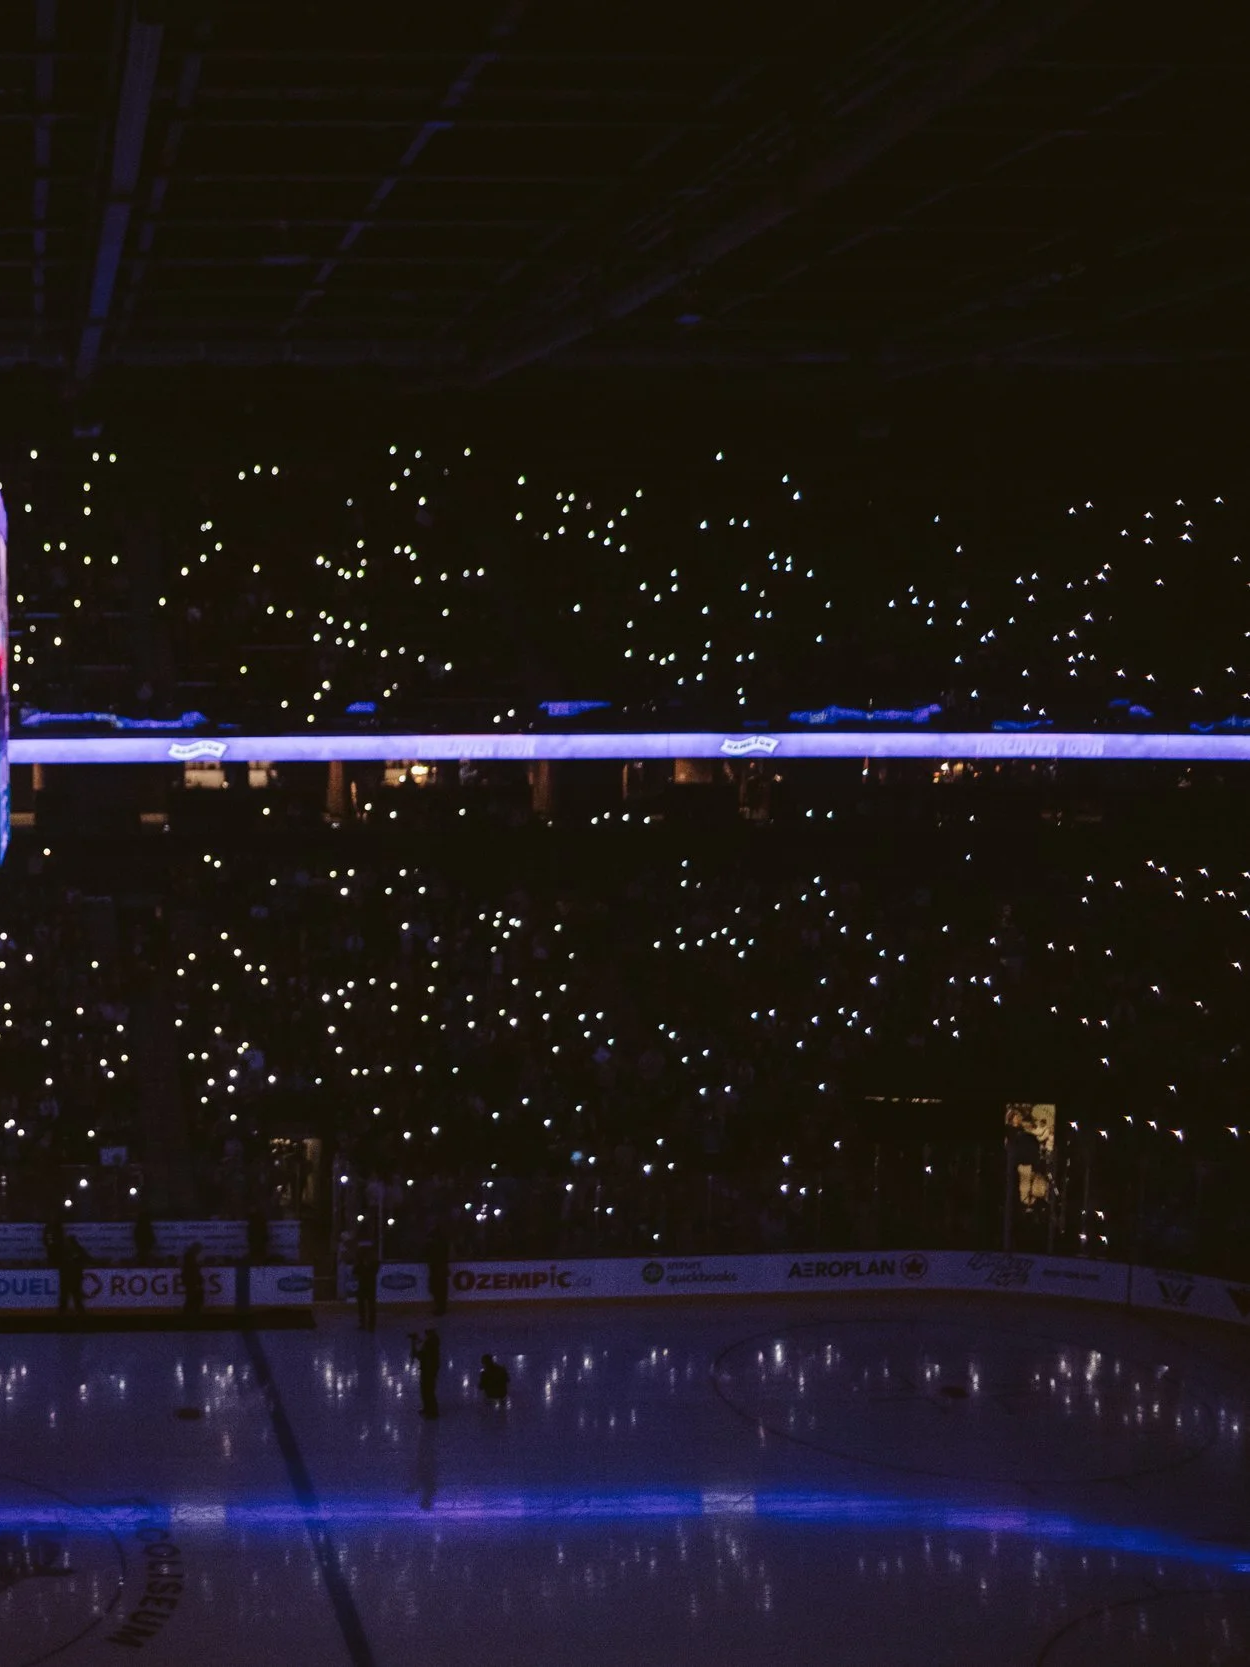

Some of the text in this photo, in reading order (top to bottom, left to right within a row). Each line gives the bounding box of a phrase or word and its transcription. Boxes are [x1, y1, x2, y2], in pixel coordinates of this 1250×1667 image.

[975, 737, 1105, 757] TAKEOVER TOUR
[788, 1259, 896, 1279] AEROPLAN
[111, 1273, 222, 1297] ROGES
